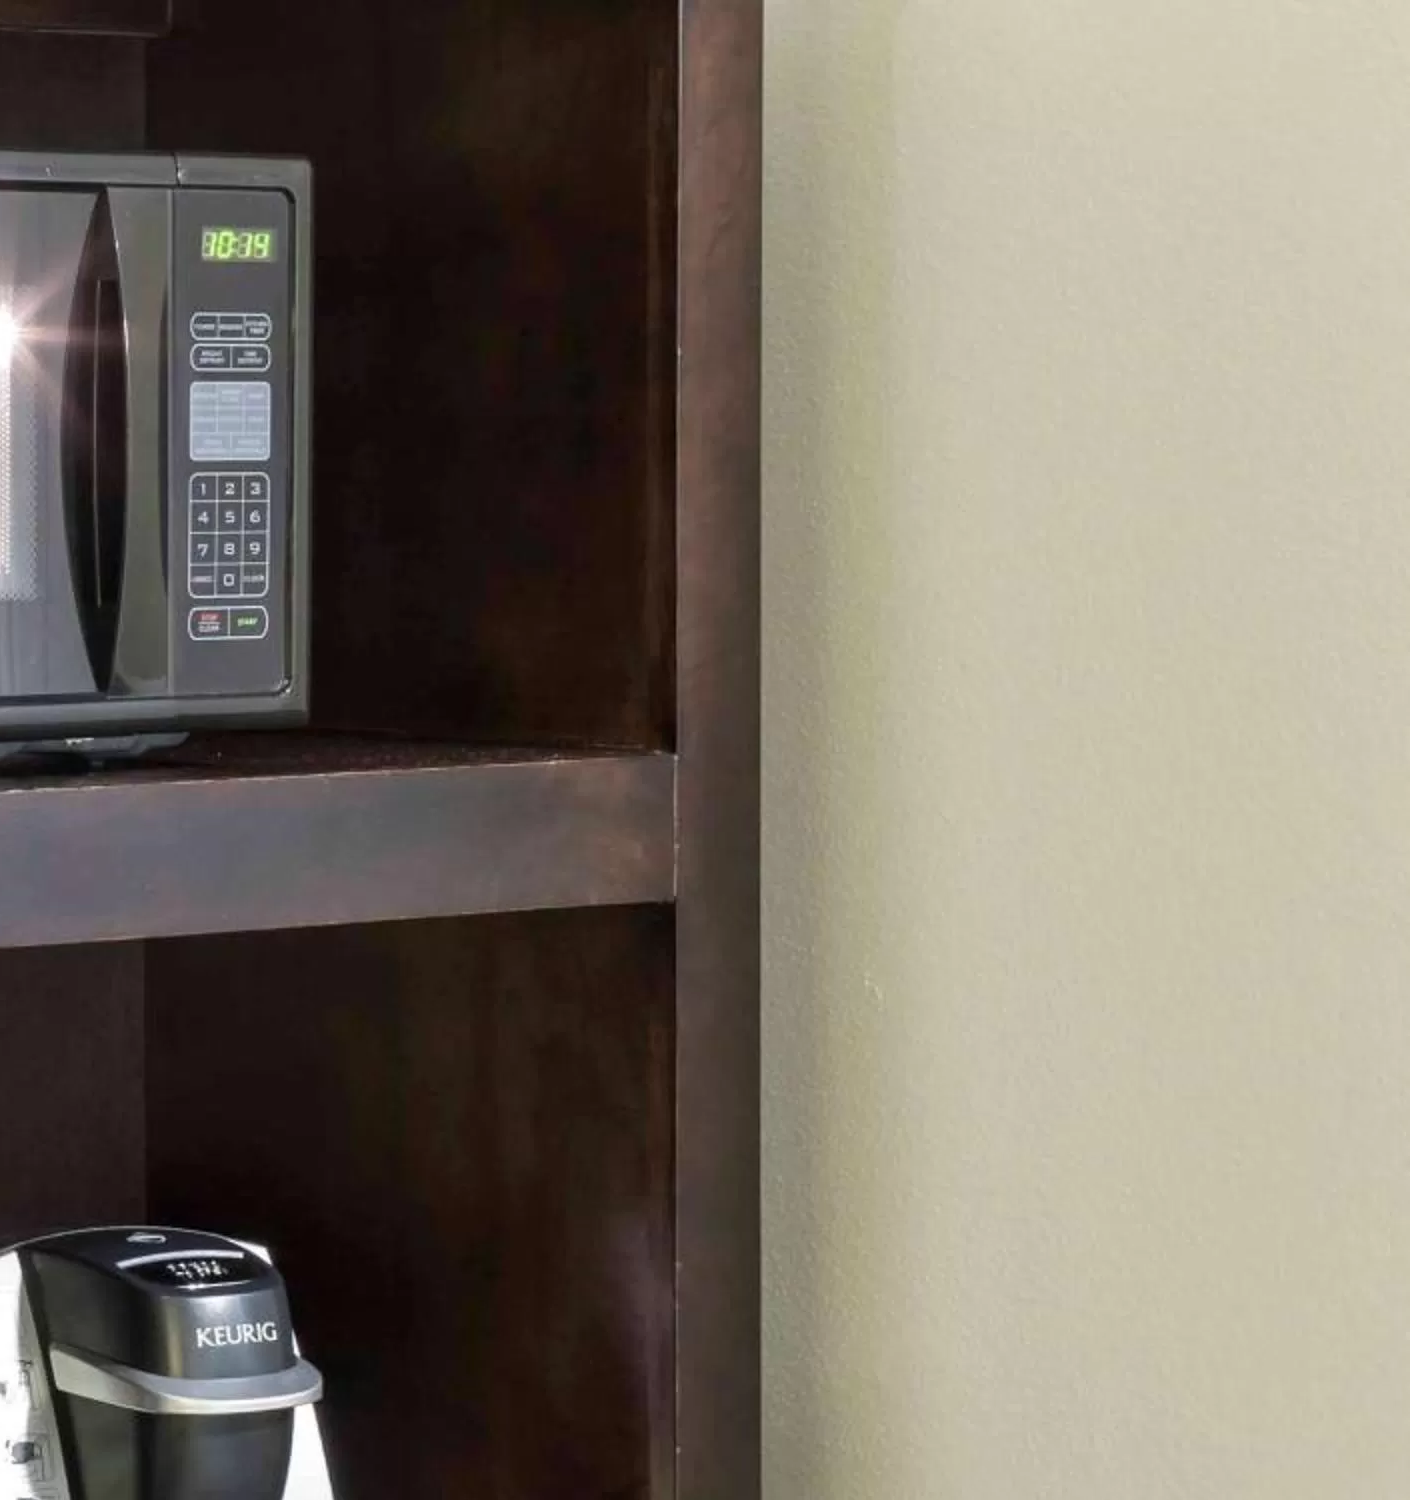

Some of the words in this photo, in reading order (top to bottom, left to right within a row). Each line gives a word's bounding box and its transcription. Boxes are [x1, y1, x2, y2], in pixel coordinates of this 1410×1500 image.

[199, 482, 207, 496] 1
[224, 482, 235, 495] 2
[250, 482, 261, 495] 3
[197, 511, 209, 525] 4
[225, 511, 235, 524] 5
[249, 510, 261, 524] 6
[197, 543, 208, 557] 7
[224, 543, 235, 555] 8
[249, 542, 261, 555] 9
[196, 1321, 279, 1349] KEURIG
